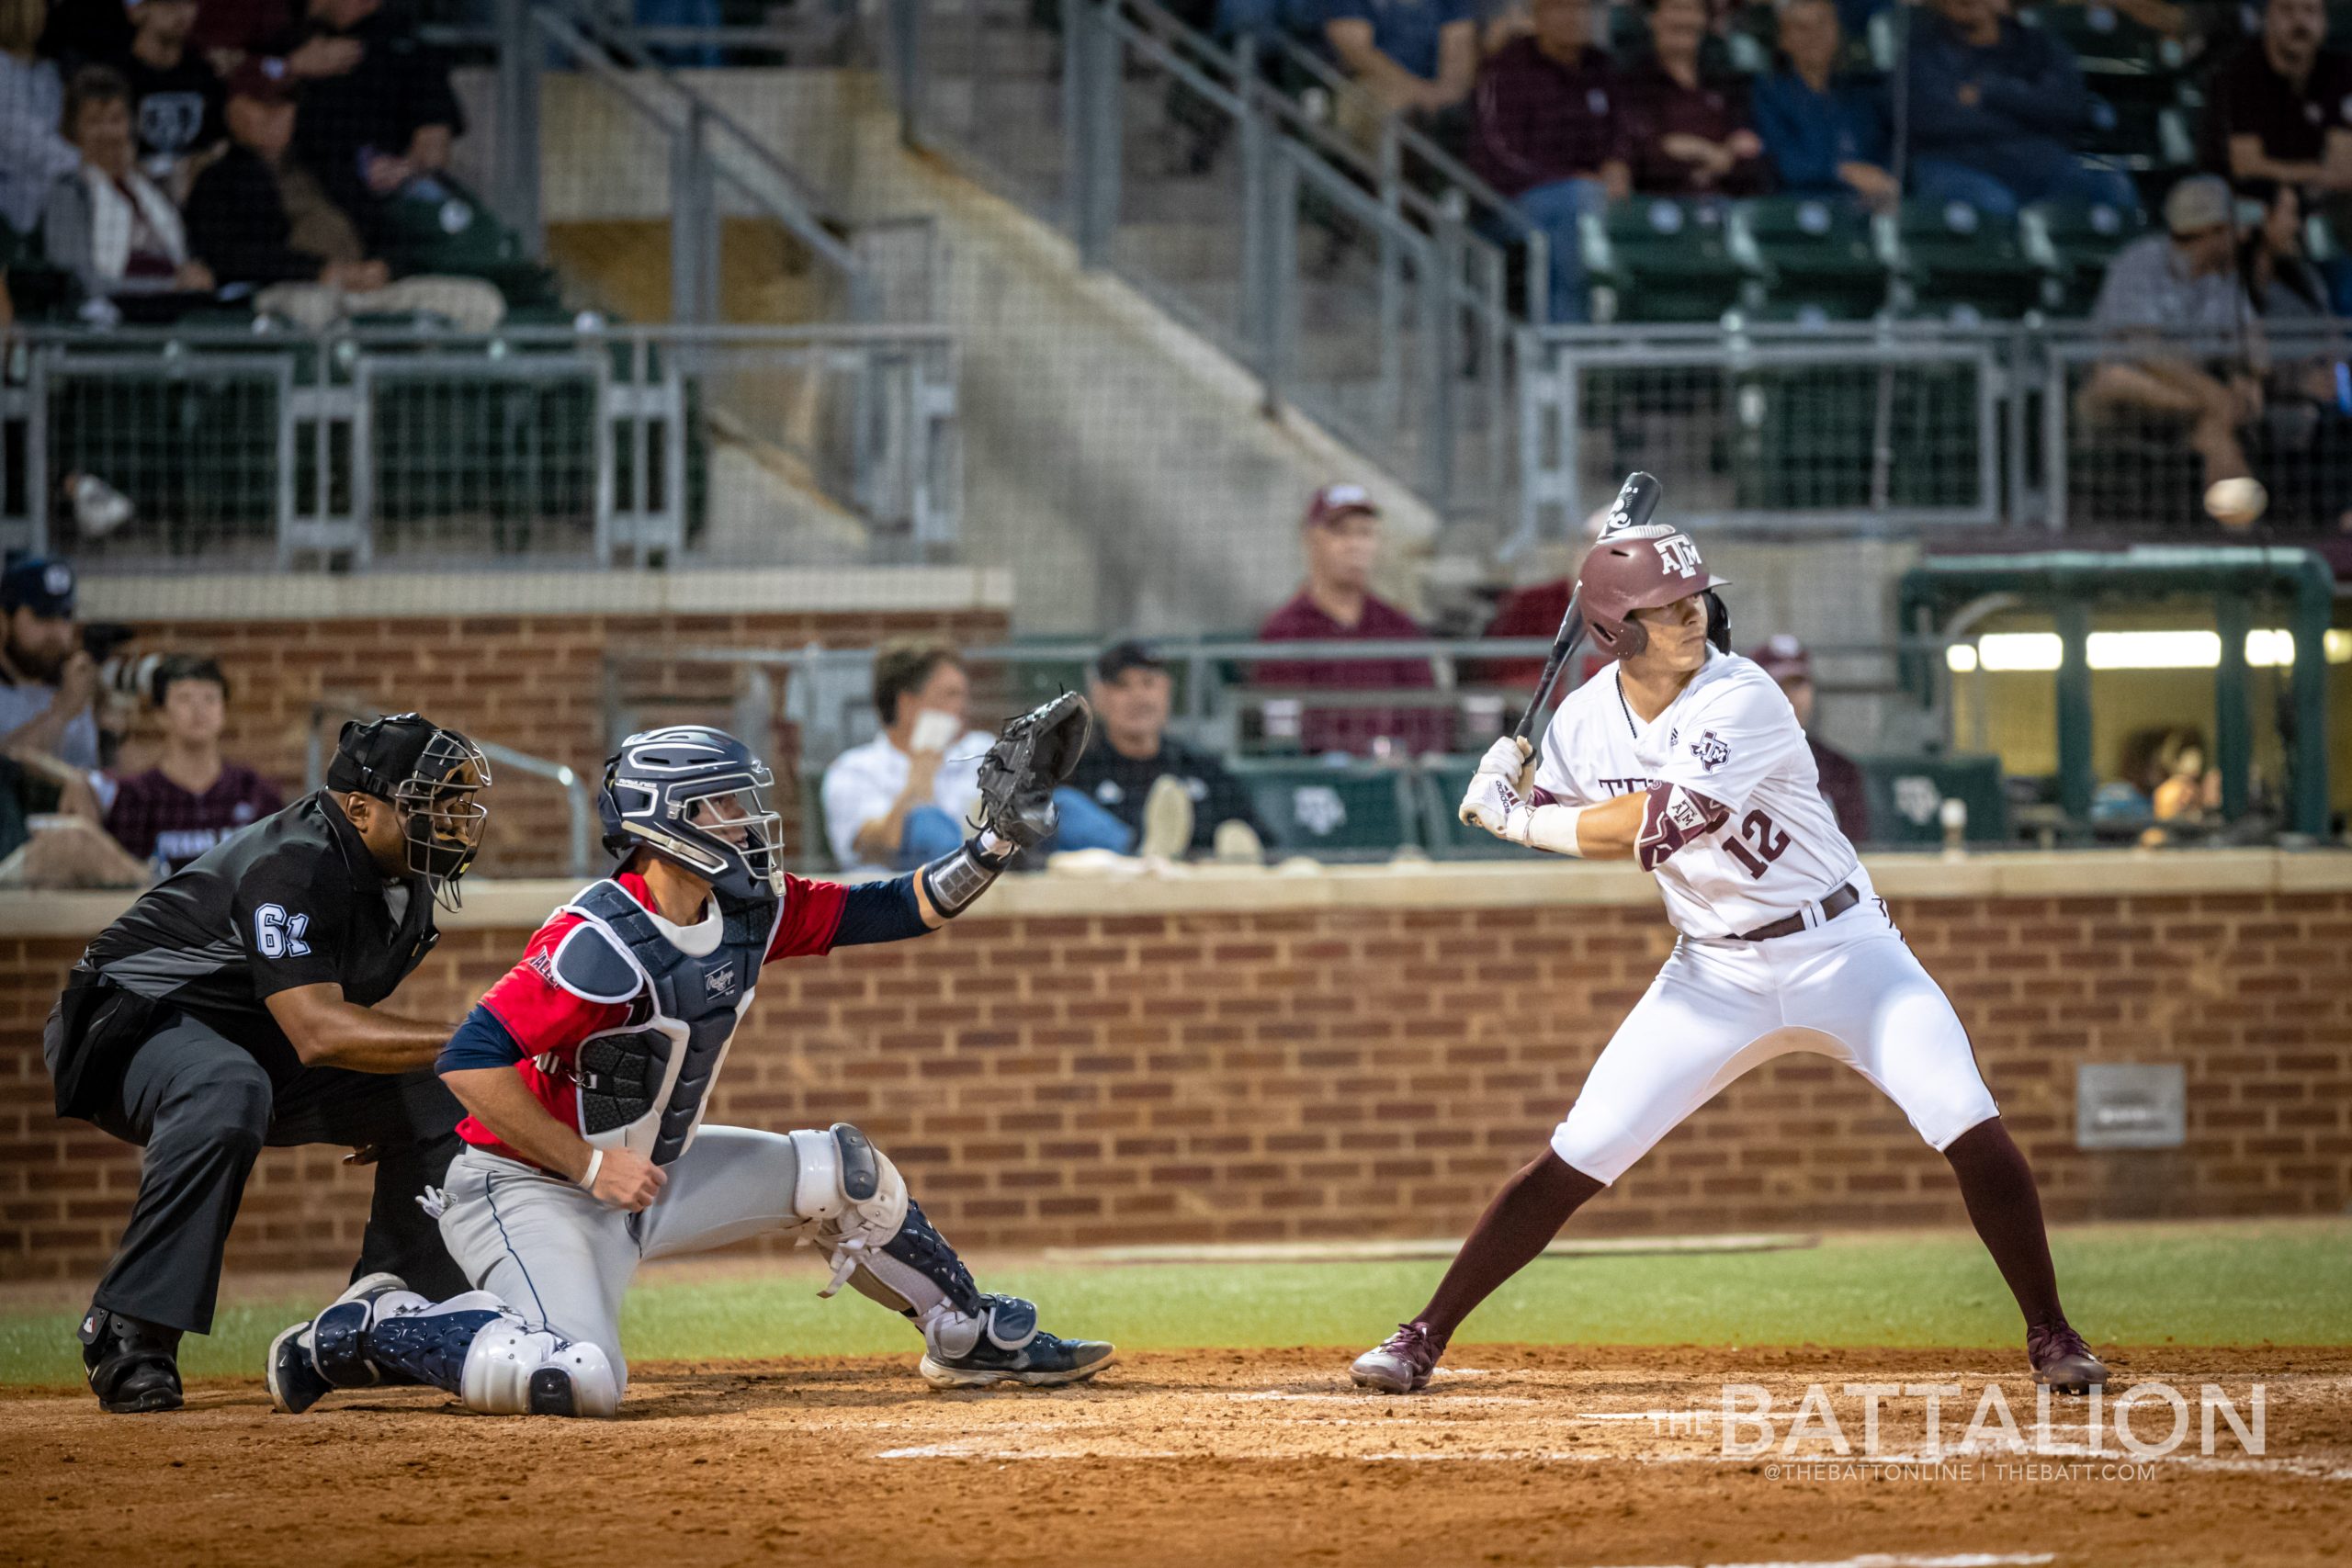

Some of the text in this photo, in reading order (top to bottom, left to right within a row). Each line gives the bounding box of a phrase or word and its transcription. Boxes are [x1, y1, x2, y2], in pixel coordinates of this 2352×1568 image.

[1496, 780, 1511, 814] adidas
[1721, 808, 1792, 880] 12
[254, 902, 311, 959] 61
